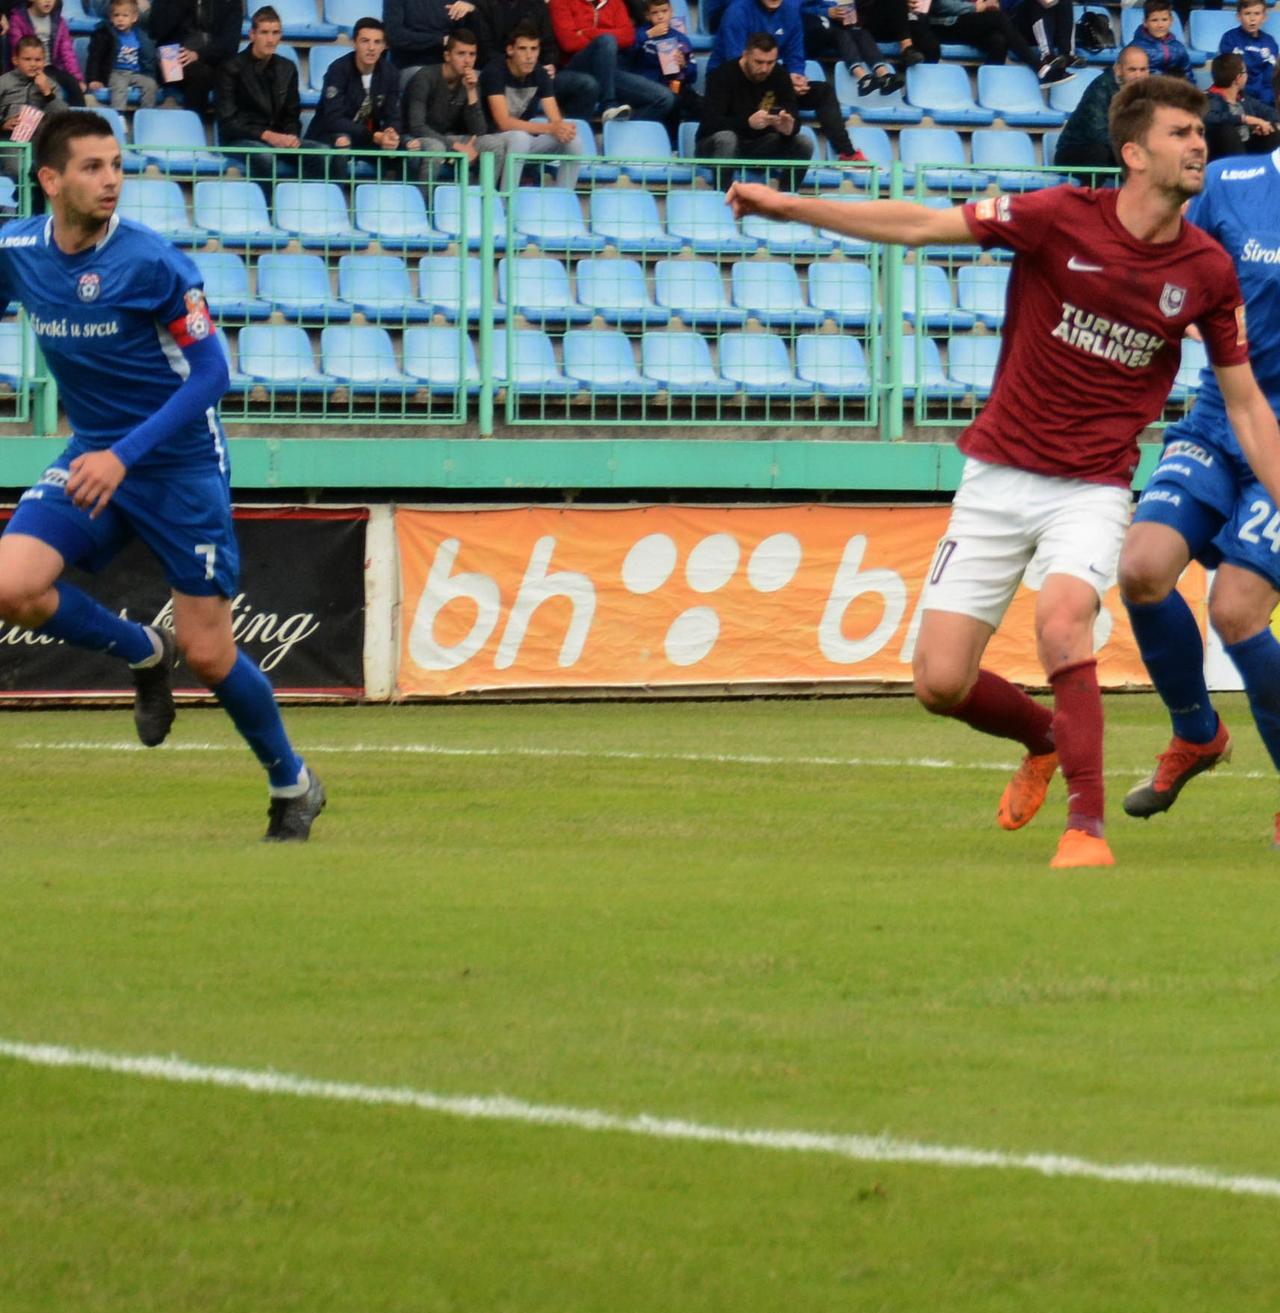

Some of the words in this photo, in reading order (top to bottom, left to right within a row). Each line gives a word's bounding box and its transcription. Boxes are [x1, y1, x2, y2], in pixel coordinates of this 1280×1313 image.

[1050, 324, 1155, 369] AIRLINES
[1060, 301, 1167, 353] TURKISH
[195, 544, 217, 580] 7
[408, 535, 597, 671] bh
